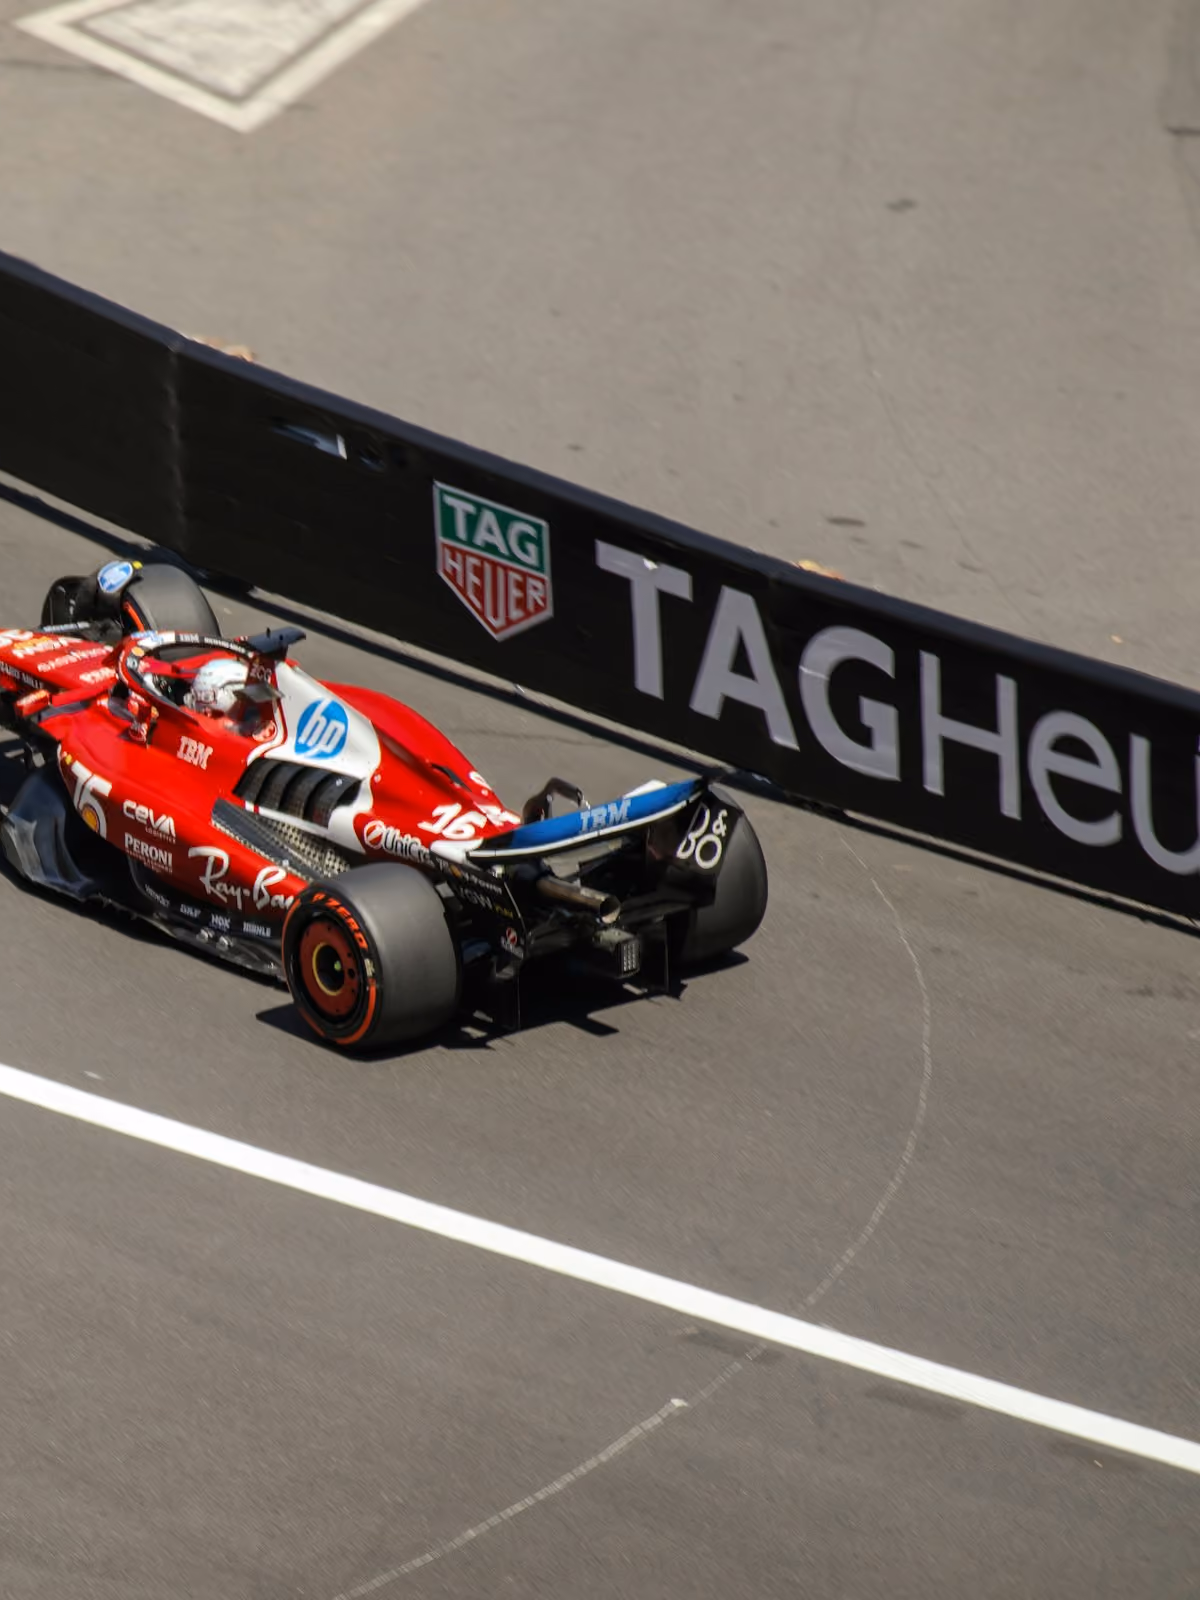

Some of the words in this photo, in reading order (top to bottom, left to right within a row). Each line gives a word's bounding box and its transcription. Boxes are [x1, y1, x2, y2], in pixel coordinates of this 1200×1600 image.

[442, 494, 540, 567] TAG
[443, 546, 546, 629] HEUER
[298, 698, 346, 757] hp
[176, 735, 214, 770] IBM
[417, 802, 488, 841] 16
[580, 799, 632, 833] IBM
[124, 832, 173, 868] PERONI
